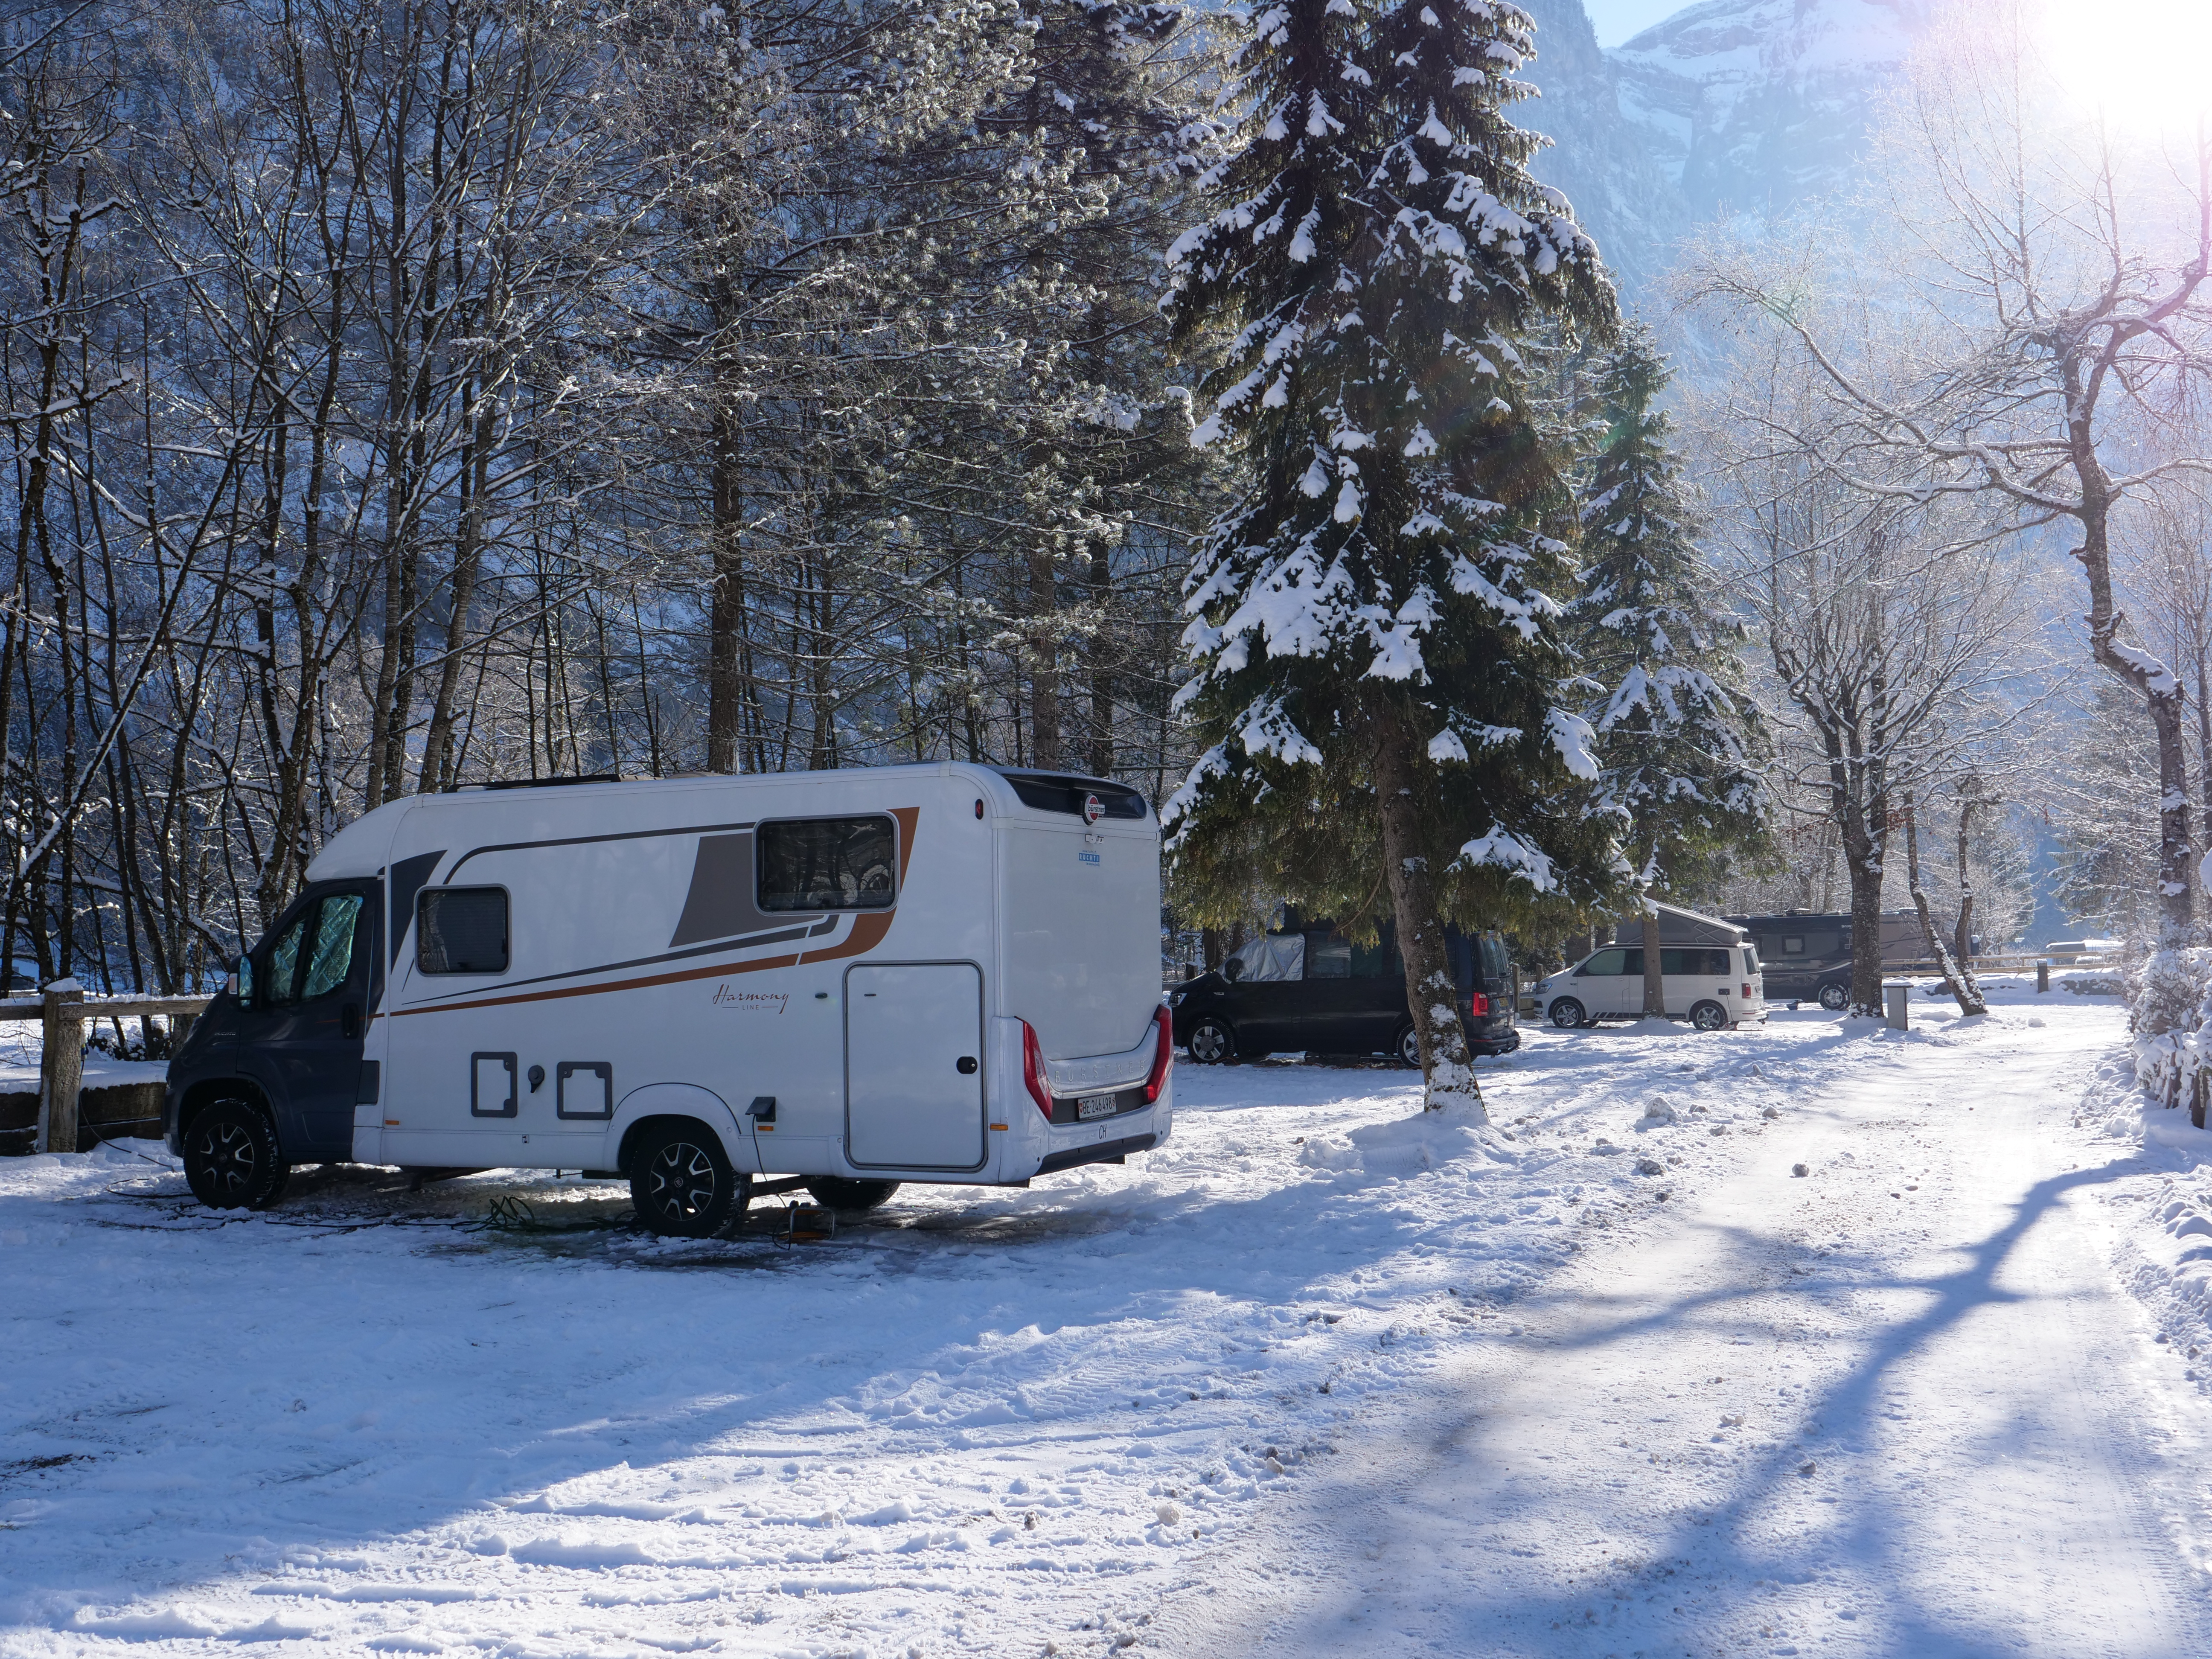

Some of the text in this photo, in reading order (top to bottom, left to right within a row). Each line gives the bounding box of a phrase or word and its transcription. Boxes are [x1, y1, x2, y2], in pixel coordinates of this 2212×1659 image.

[1088, 804, 1105, 813] bürstner
[713, 984, 789, 1014] Harmony
[63, 1007, 81, 1018] 526
[1055, 1060, 1145, 1083] BÜRSTNER
[1099, 1123, 1107, 1140] CH
